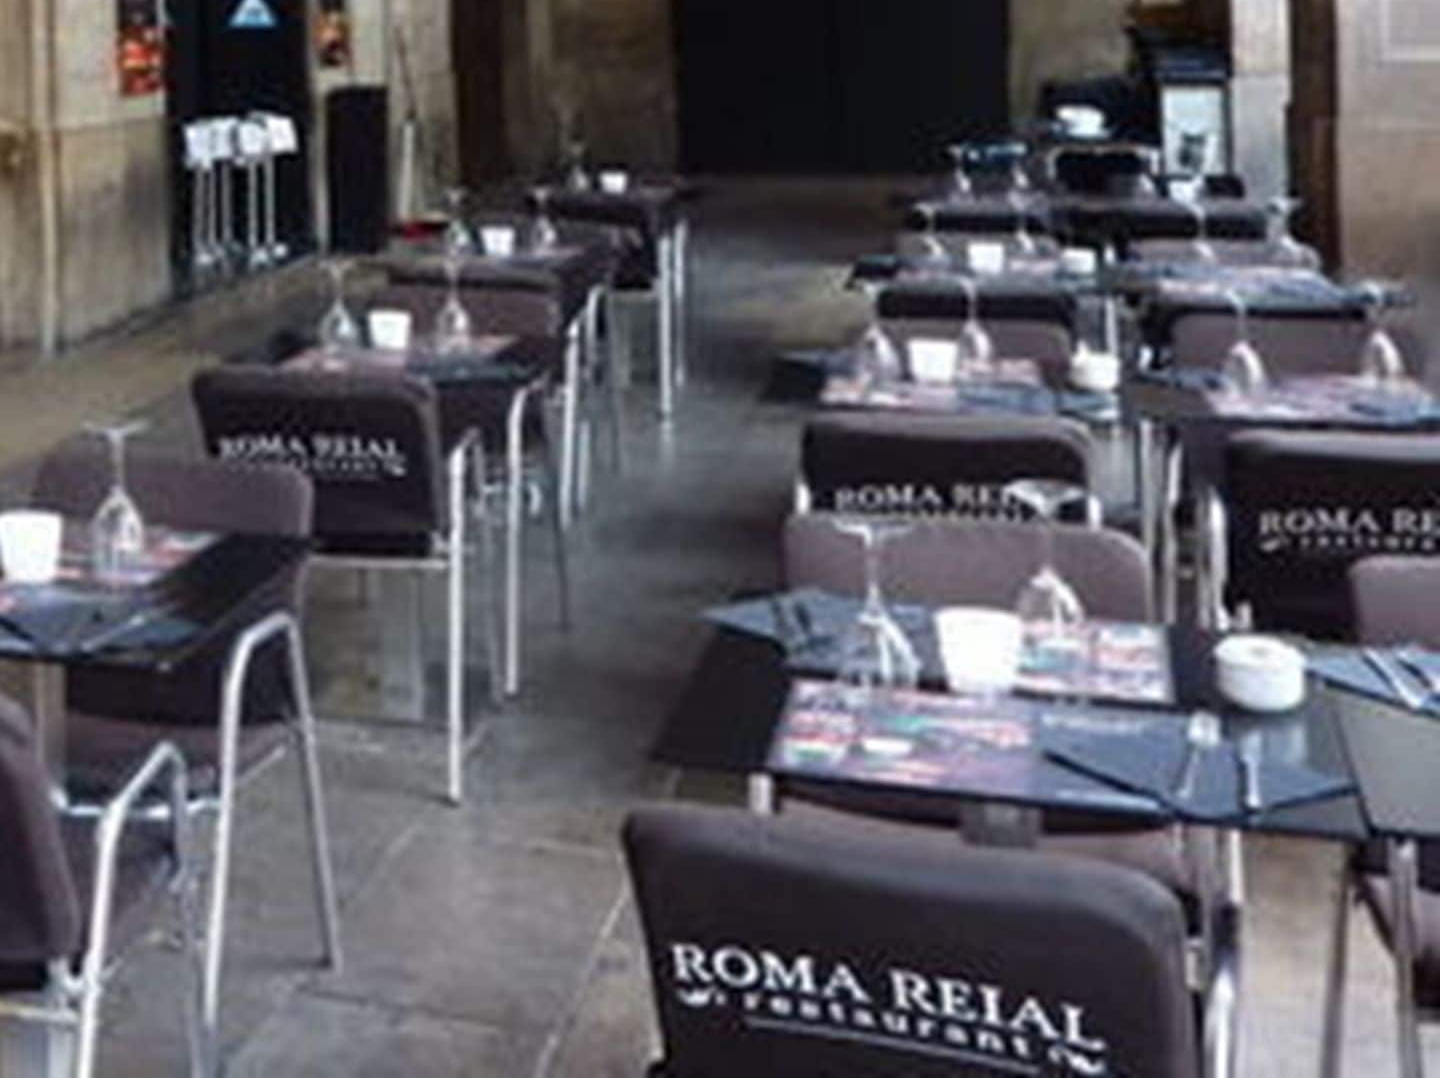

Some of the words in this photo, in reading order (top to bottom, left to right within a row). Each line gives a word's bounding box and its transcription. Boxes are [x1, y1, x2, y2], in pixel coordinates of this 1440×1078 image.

[218, 432, 308, 459] ROMA
[834, 483, 942, 511] ROMA
[1259, 507, 1380, 534] ROMA
[670, 942, 872, 1004] ROMA
[888, 966, 1108, 1052] REIAL
[743, 990, 1034, 1058] restaurant
